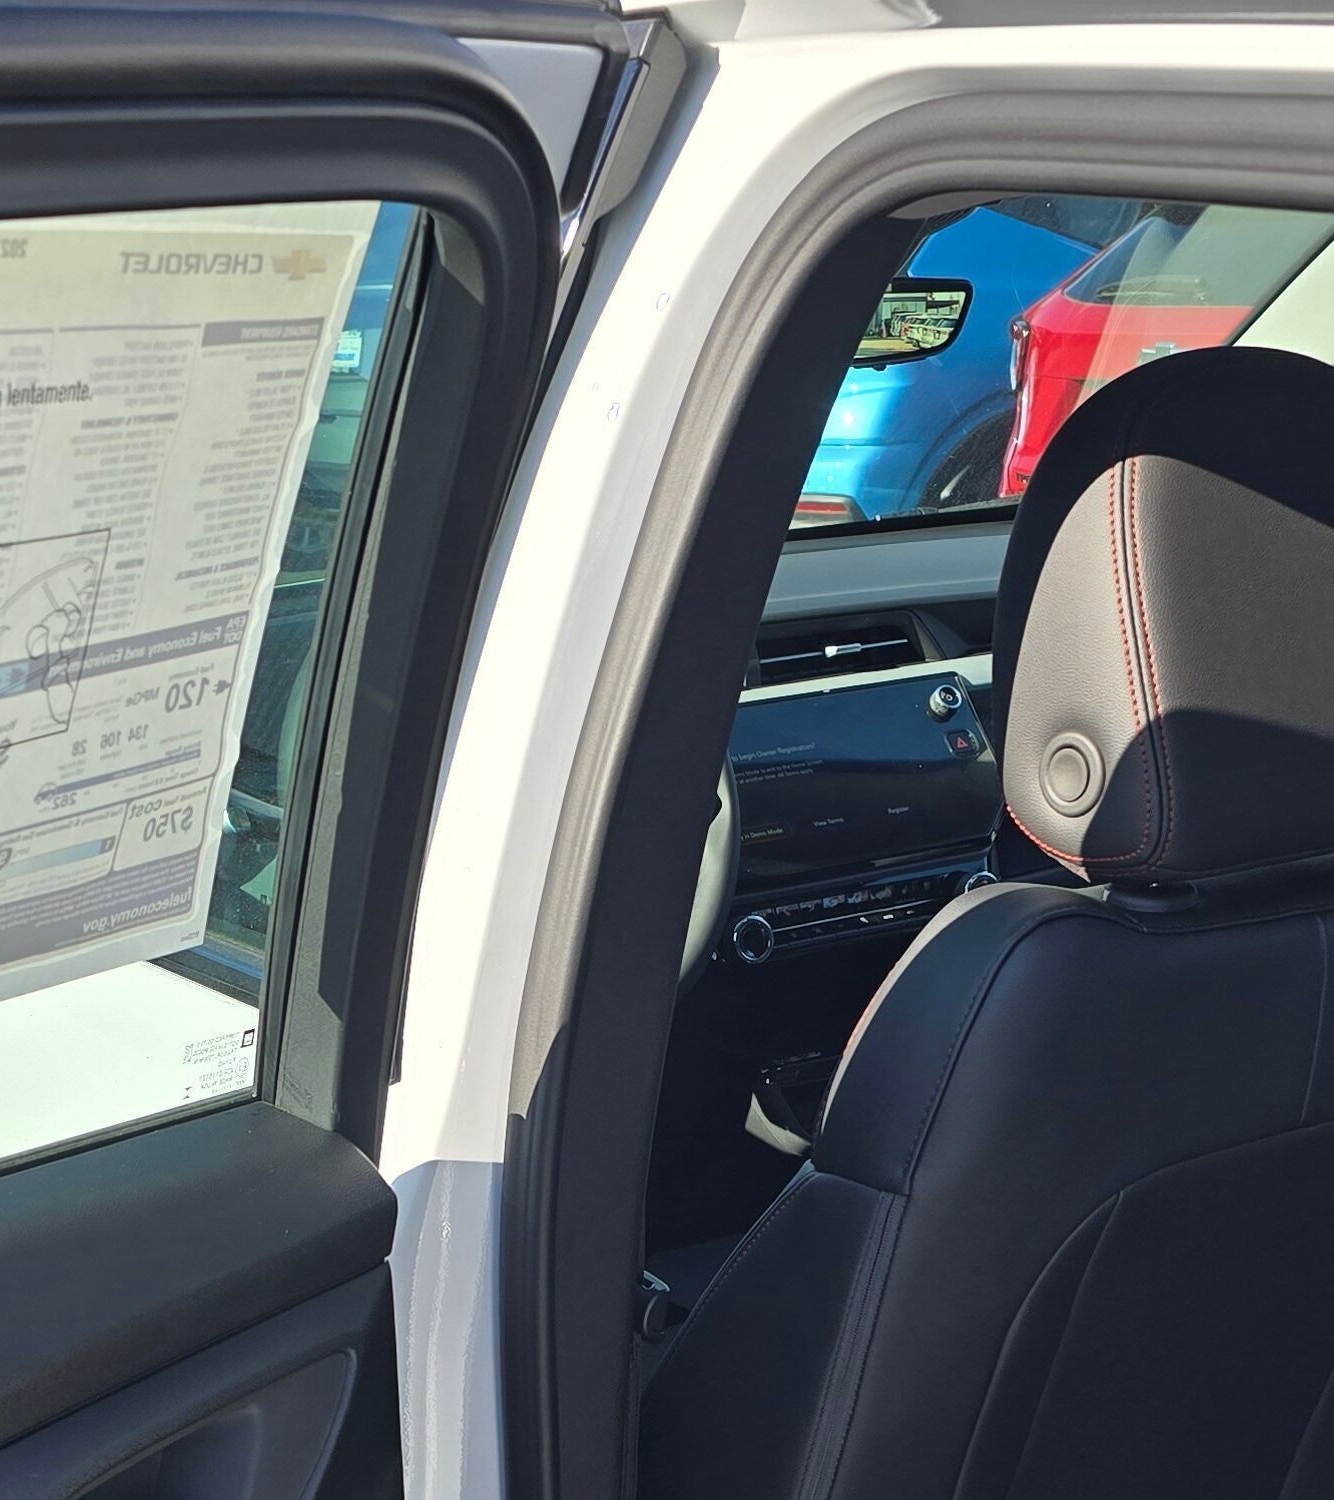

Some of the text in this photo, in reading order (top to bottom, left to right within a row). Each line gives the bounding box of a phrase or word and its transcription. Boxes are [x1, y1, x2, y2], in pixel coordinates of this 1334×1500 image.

[6, 379, 93, 407] lentamente.
[756, 750, 777, 759] Owner
[777, 742, 815, 754] Registration?
[813, 819, 827, 828] View
